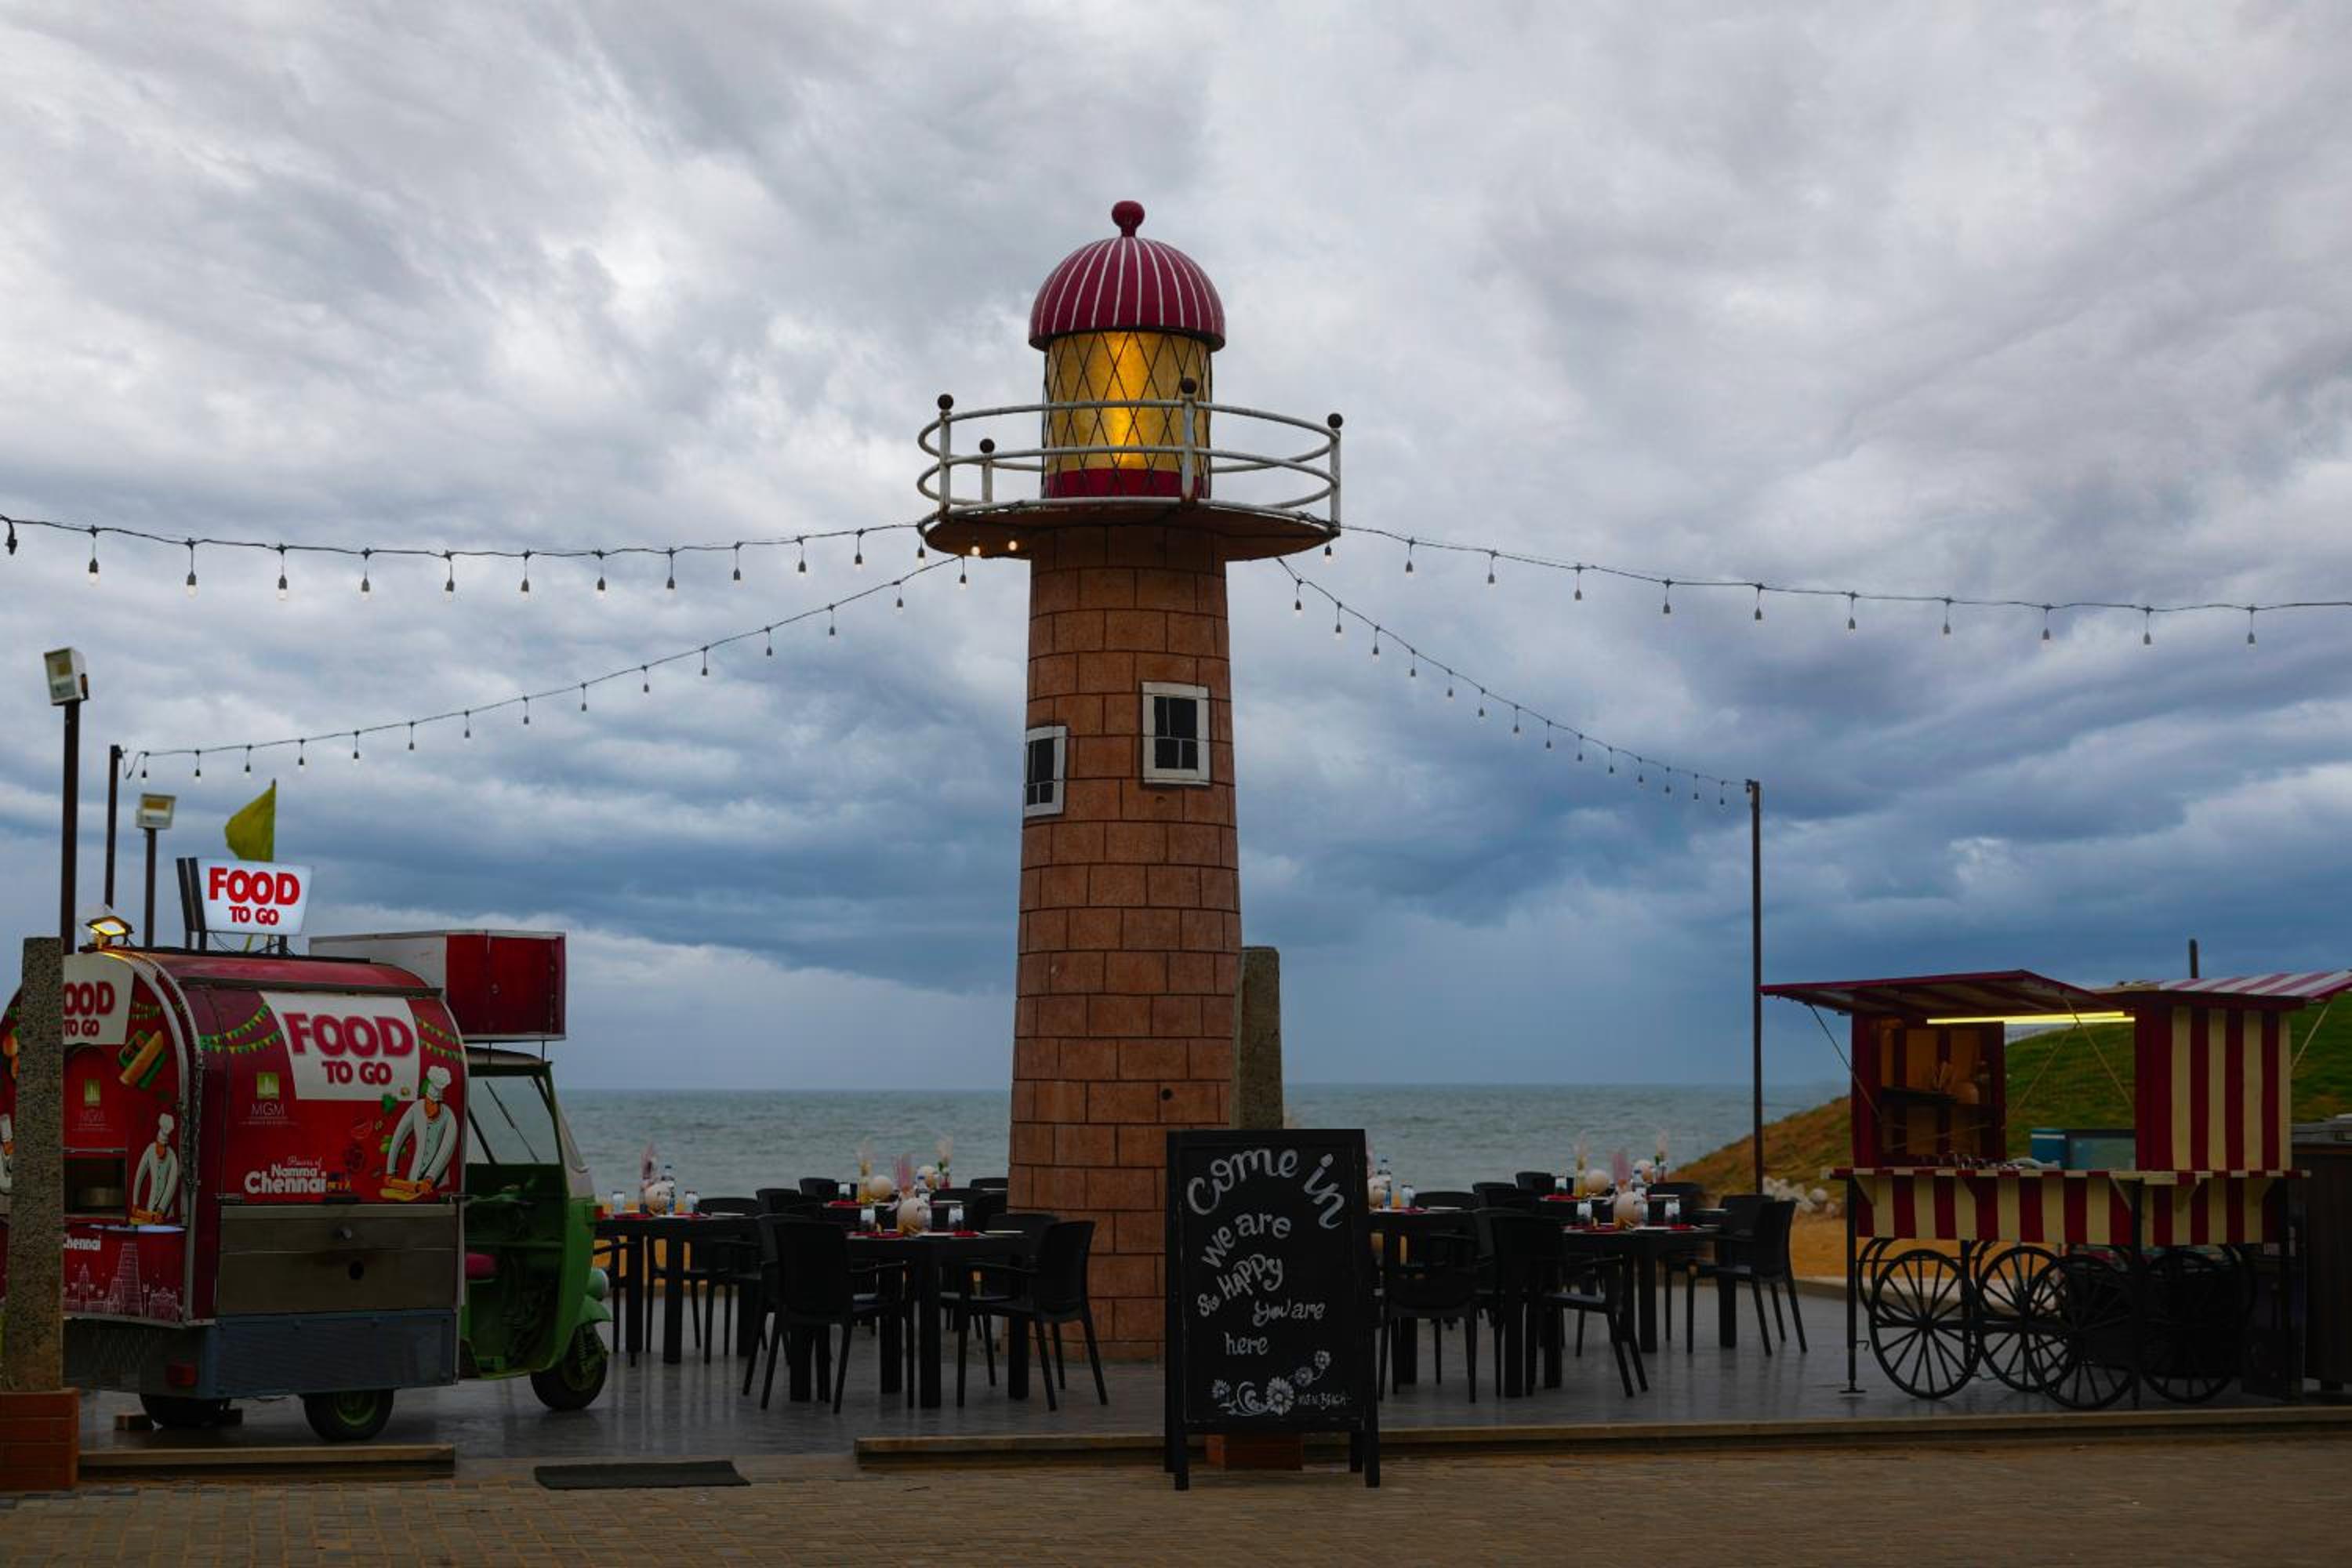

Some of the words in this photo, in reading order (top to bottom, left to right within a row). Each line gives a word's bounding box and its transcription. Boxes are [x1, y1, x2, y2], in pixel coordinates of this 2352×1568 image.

[209, 866, 300, 906] FOOD
[229, 906, 251, 924] TO
[255, 907, 279, 926] GO
[64, 981, 115, 1016] OOD
[64, 1018, 78, 1036] TO
[81, 1018, 100, 1037] GO
[282, 1013, 415, 1058] FOOD
[321, 1060, 353, 1085] TO
[358, 1061, 393, 1086] GO
[251, 1102, 285, 1117] MGM
[244, 1170, 327, 1194] Chennai
[270, 1162, 318, 1178] Namma
[1186, 1147, 1300, 1216] Come
[1303, 1152, 1346, 1229] in
[1234, 1212, 1292, 1240] are
[1251, 1298, 1291, 1327] you
[1291, 1301, 1326, 1321] are
[1224, 1331, 1269, 1356] here
